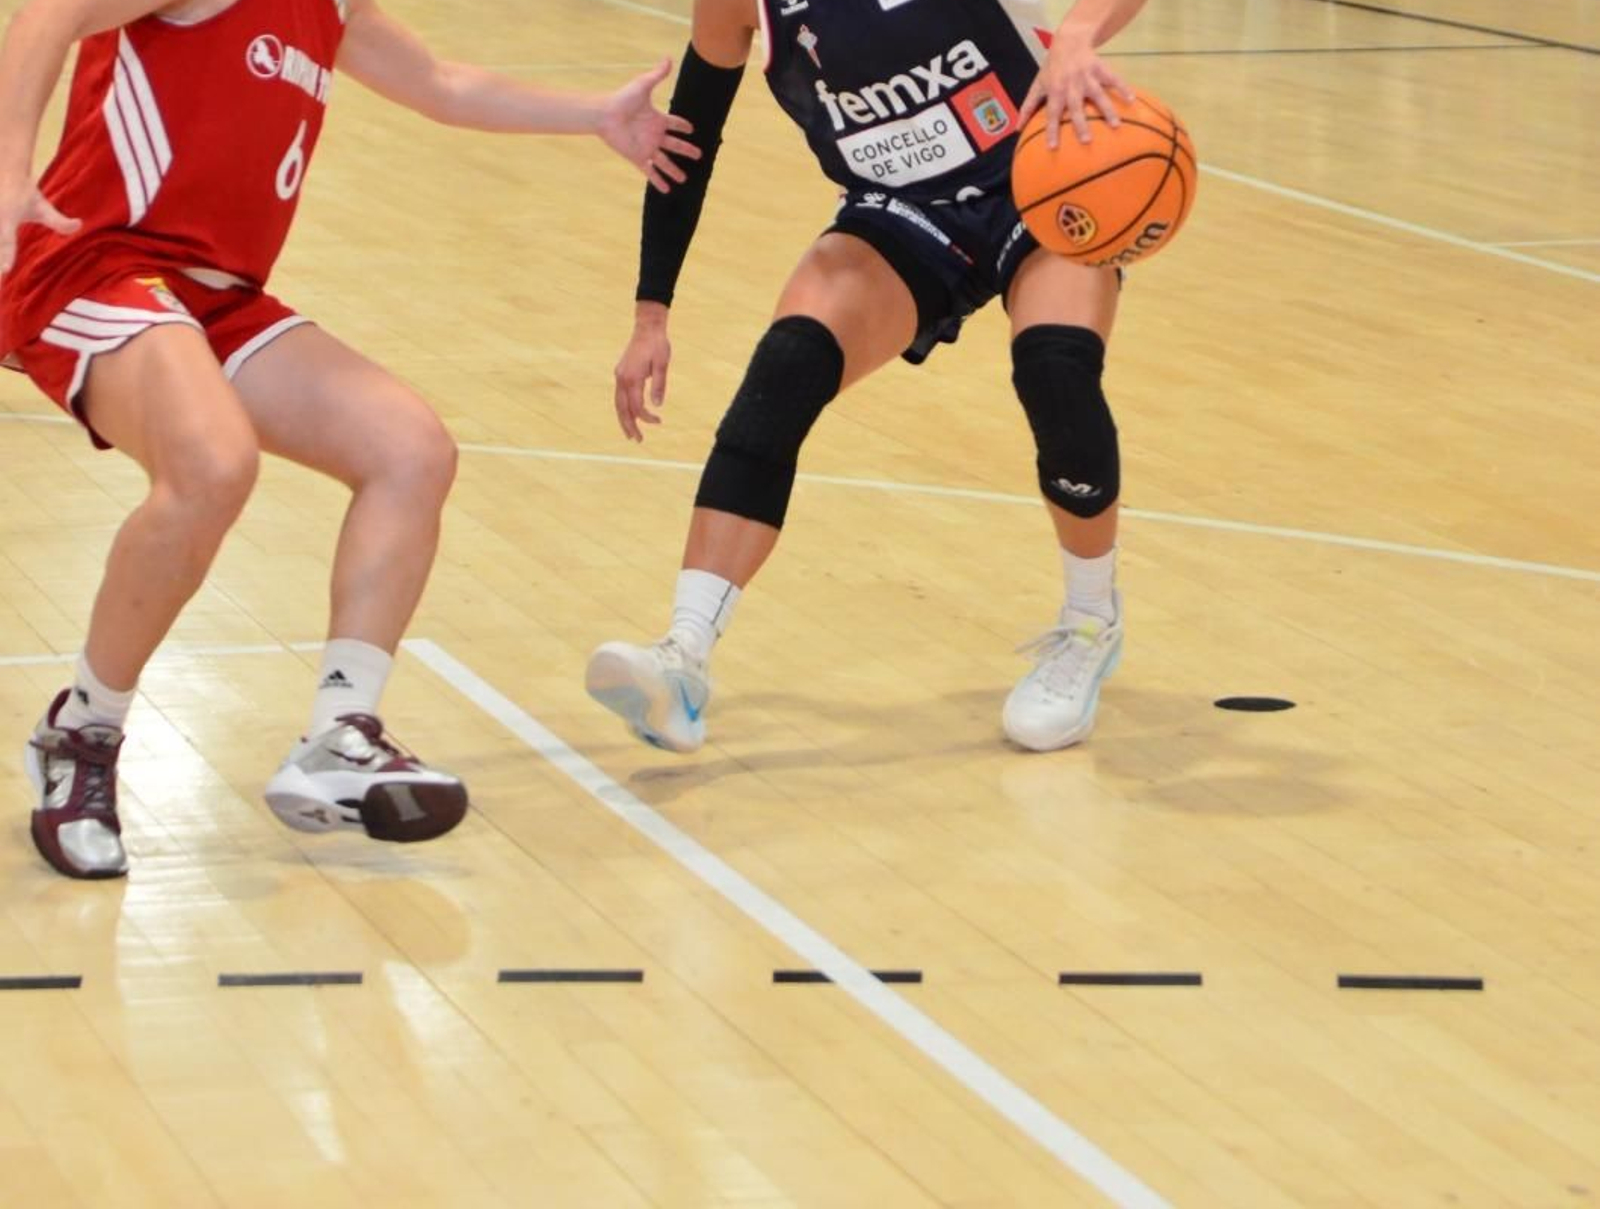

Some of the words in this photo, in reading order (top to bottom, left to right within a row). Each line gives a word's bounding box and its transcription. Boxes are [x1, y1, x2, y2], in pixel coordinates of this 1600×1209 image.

[814, 38, 990, 132] femxa
[275, 120, 307, 201] 6
[851, 119, 948, 164] CONCELLO
[872, 158, 898, 178] DE
[900, 144, 947, 169] VIGO
